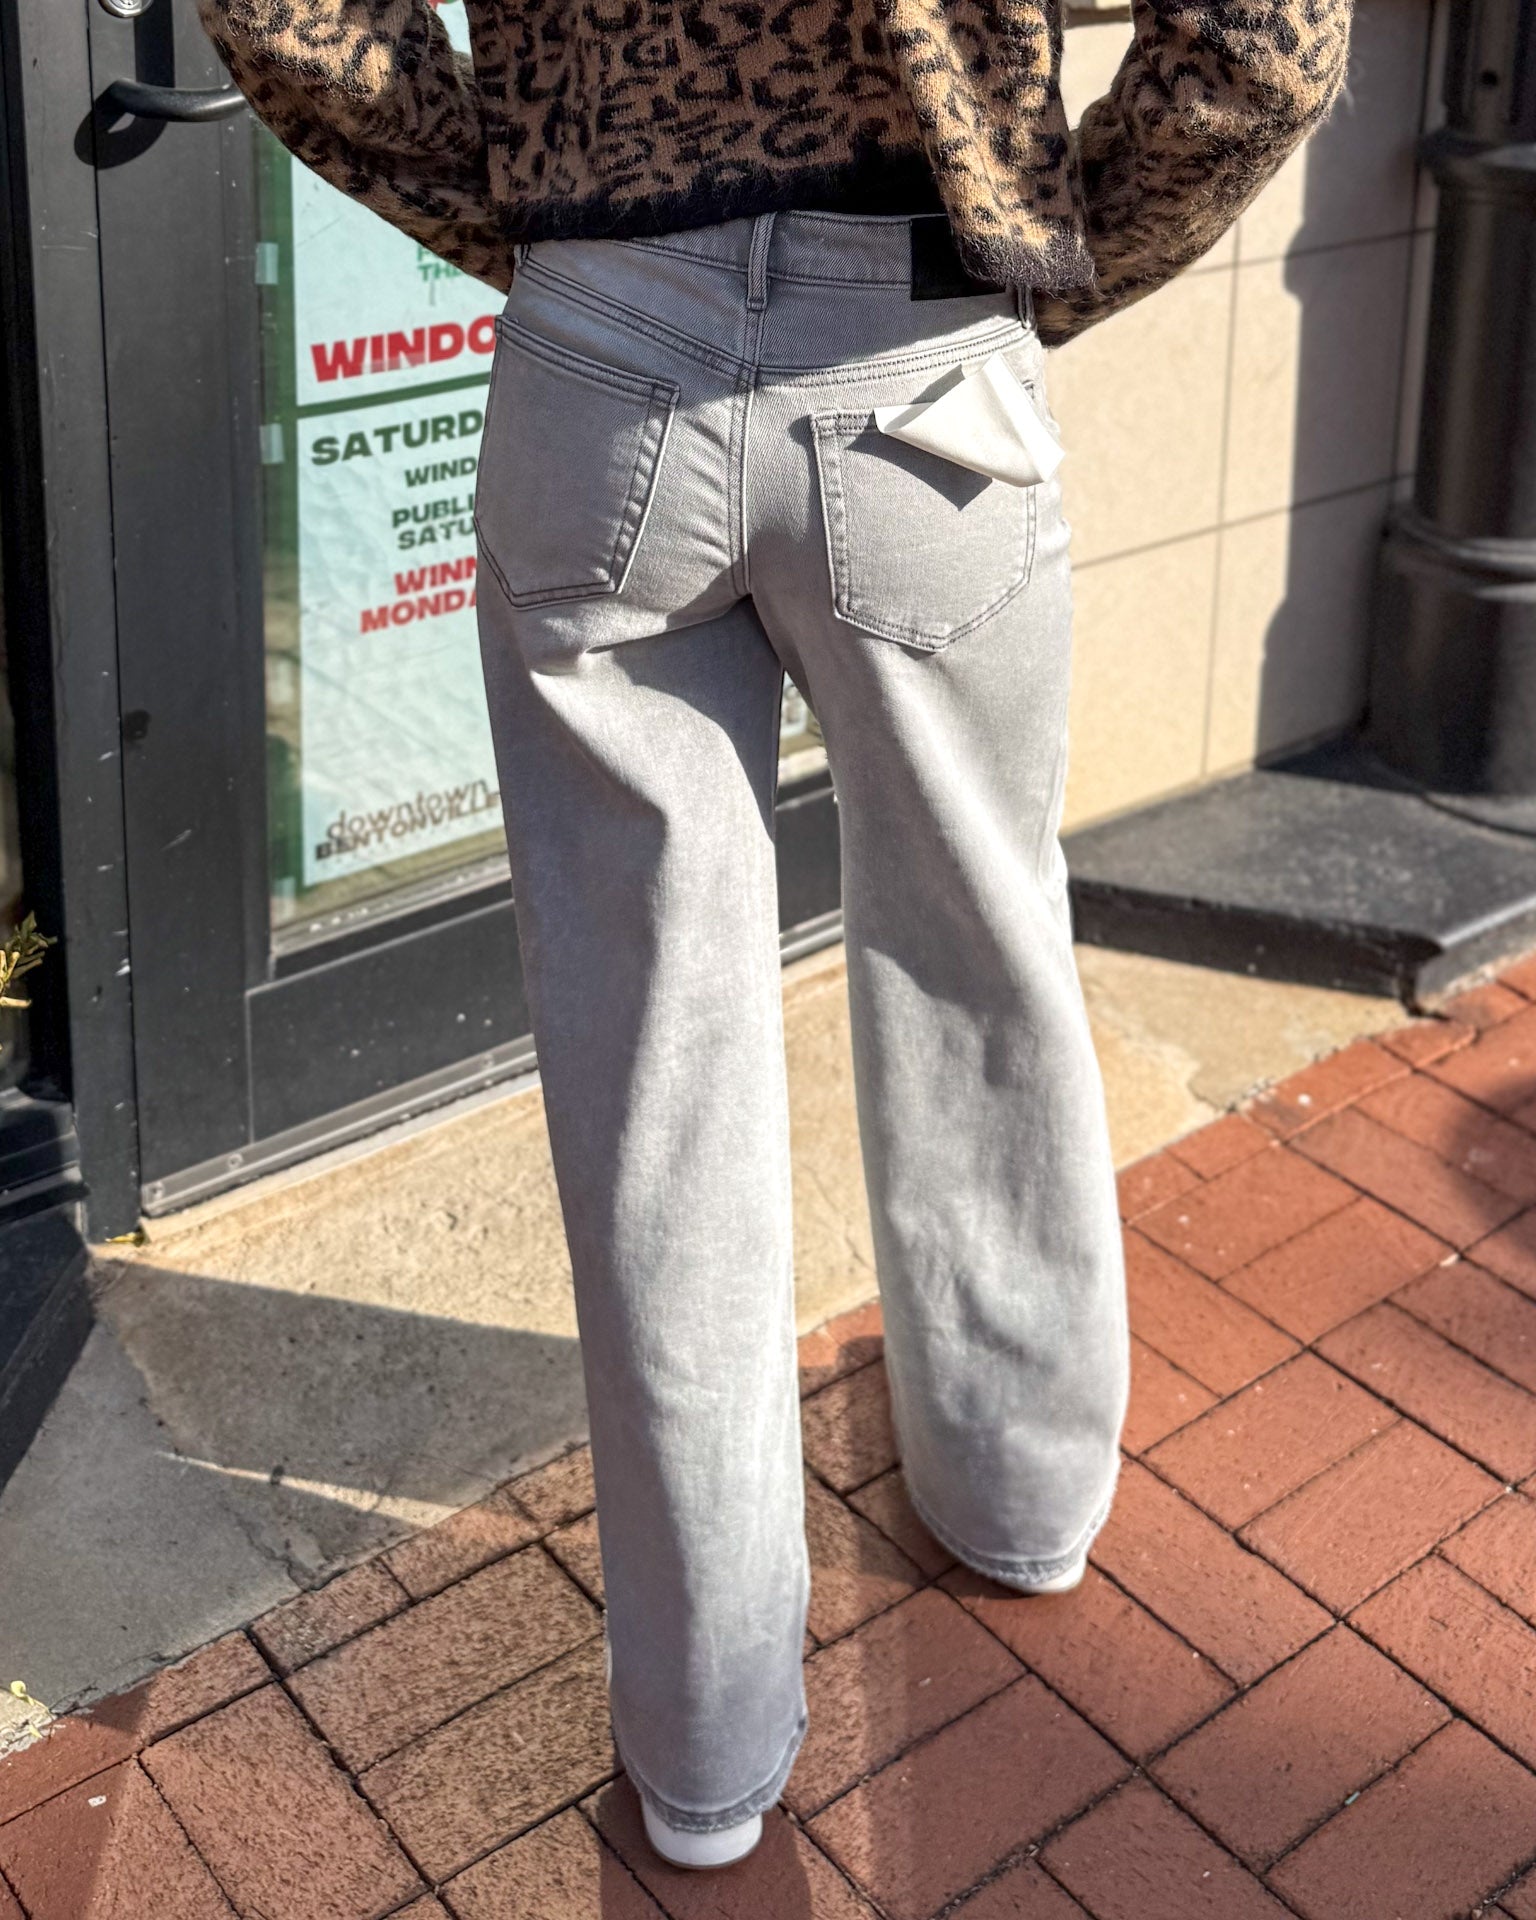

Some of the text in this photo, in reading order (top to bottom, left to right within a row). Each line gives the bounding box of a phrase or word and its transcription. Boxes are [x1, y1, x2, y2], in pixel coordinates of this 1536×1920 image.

[310, 314, 496, 382] WINDO
[311, 409, 484, 466] SATURD
[404, 456, 477, 488] WIND
[392, 493, 474, 529] PUBLI
